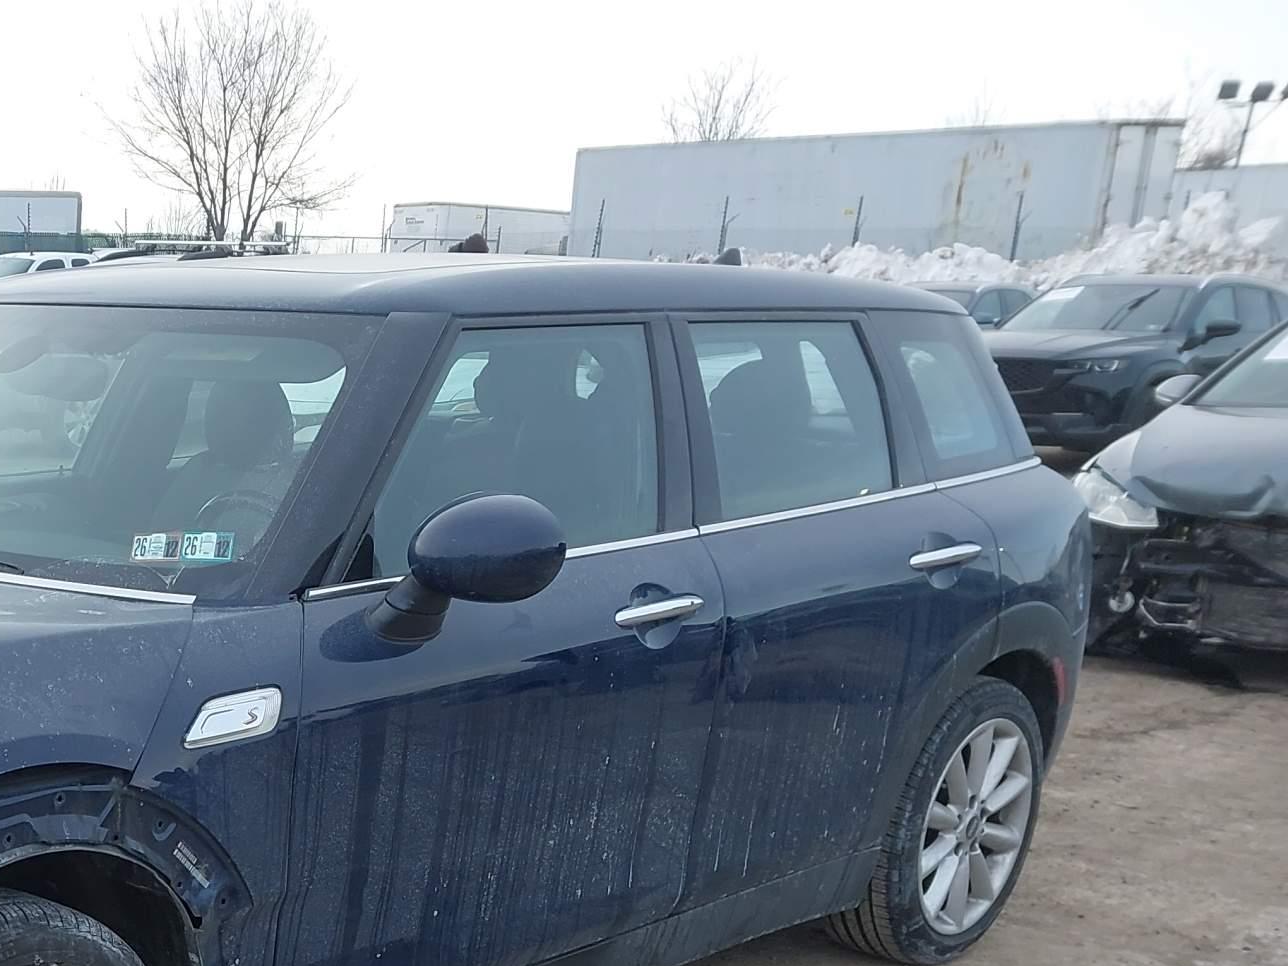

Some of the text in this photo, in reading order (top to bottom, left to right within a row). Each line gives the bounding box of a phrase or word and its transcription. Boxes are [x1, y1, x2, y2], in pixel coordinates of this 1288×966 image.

[134, 537, 148, 557] 26
[164, 540, 179, 558] 12
[184, 536, 199, 556] 26
[215, 540, 231, 558] 12
[243, 706, 258, 725] S
